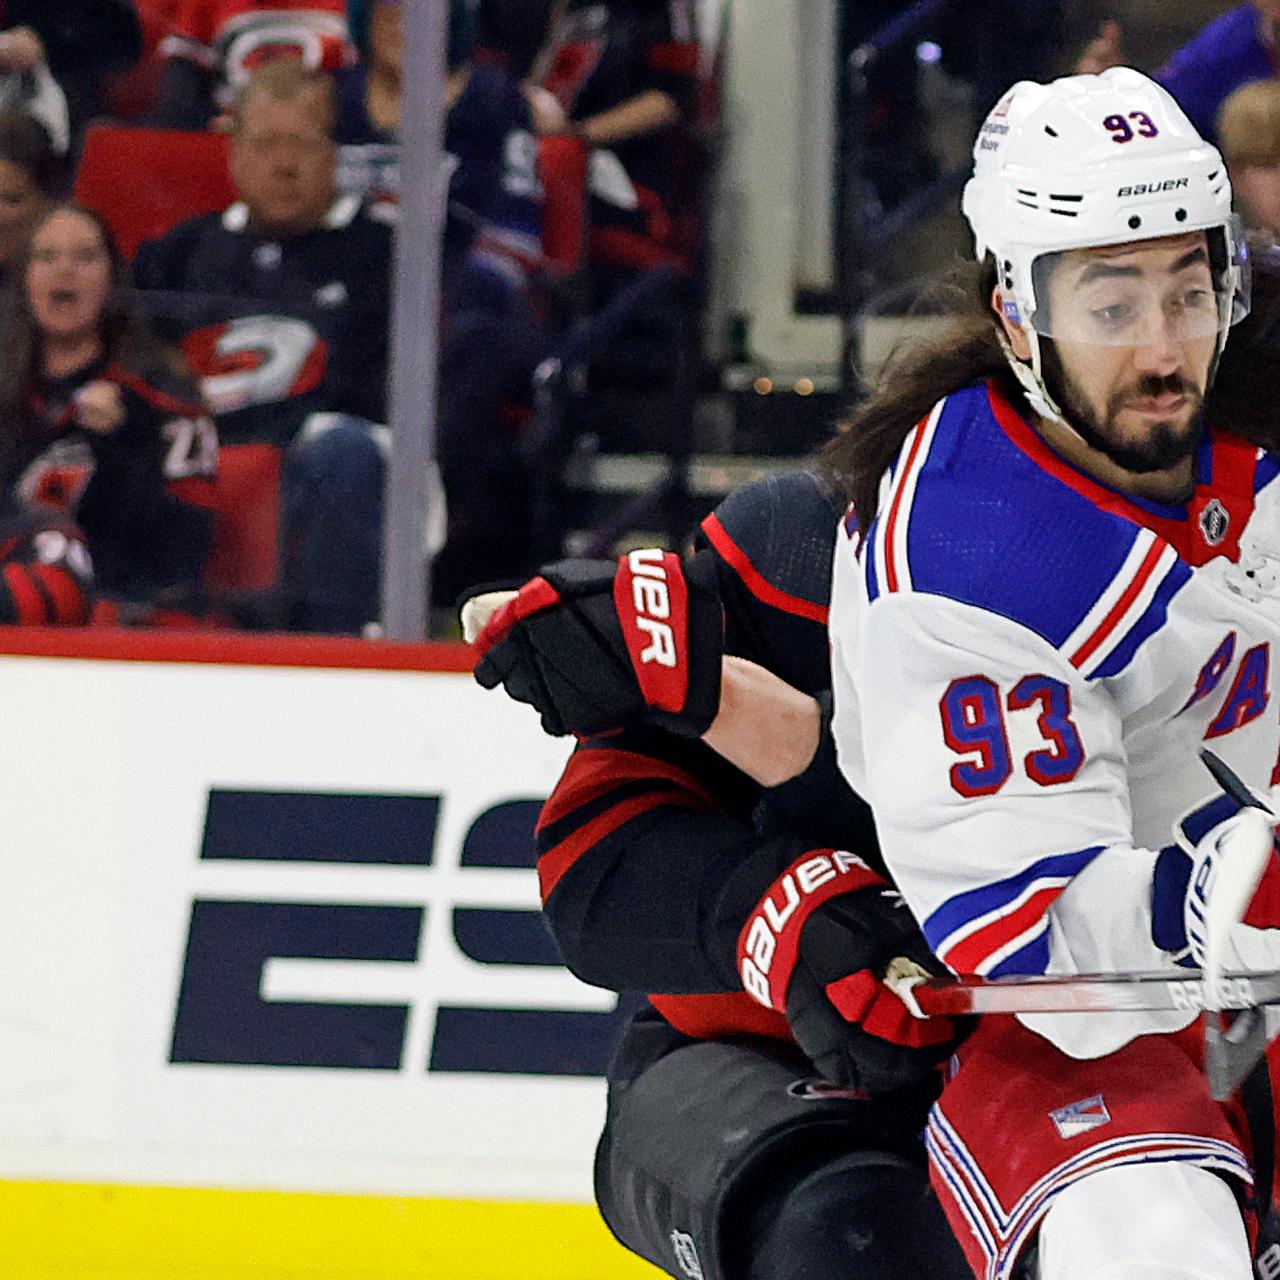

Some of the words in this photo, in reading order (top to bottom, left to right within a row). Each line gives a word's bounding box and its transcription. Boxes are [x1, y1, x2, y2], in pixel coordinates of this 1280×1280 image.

[1102, 109, 1160, 144] 93
[1117, 177, 1189, 198] BAUER
[939, 673, 1086, 798] 93
[741, 849, 872, 1009] BAUER
